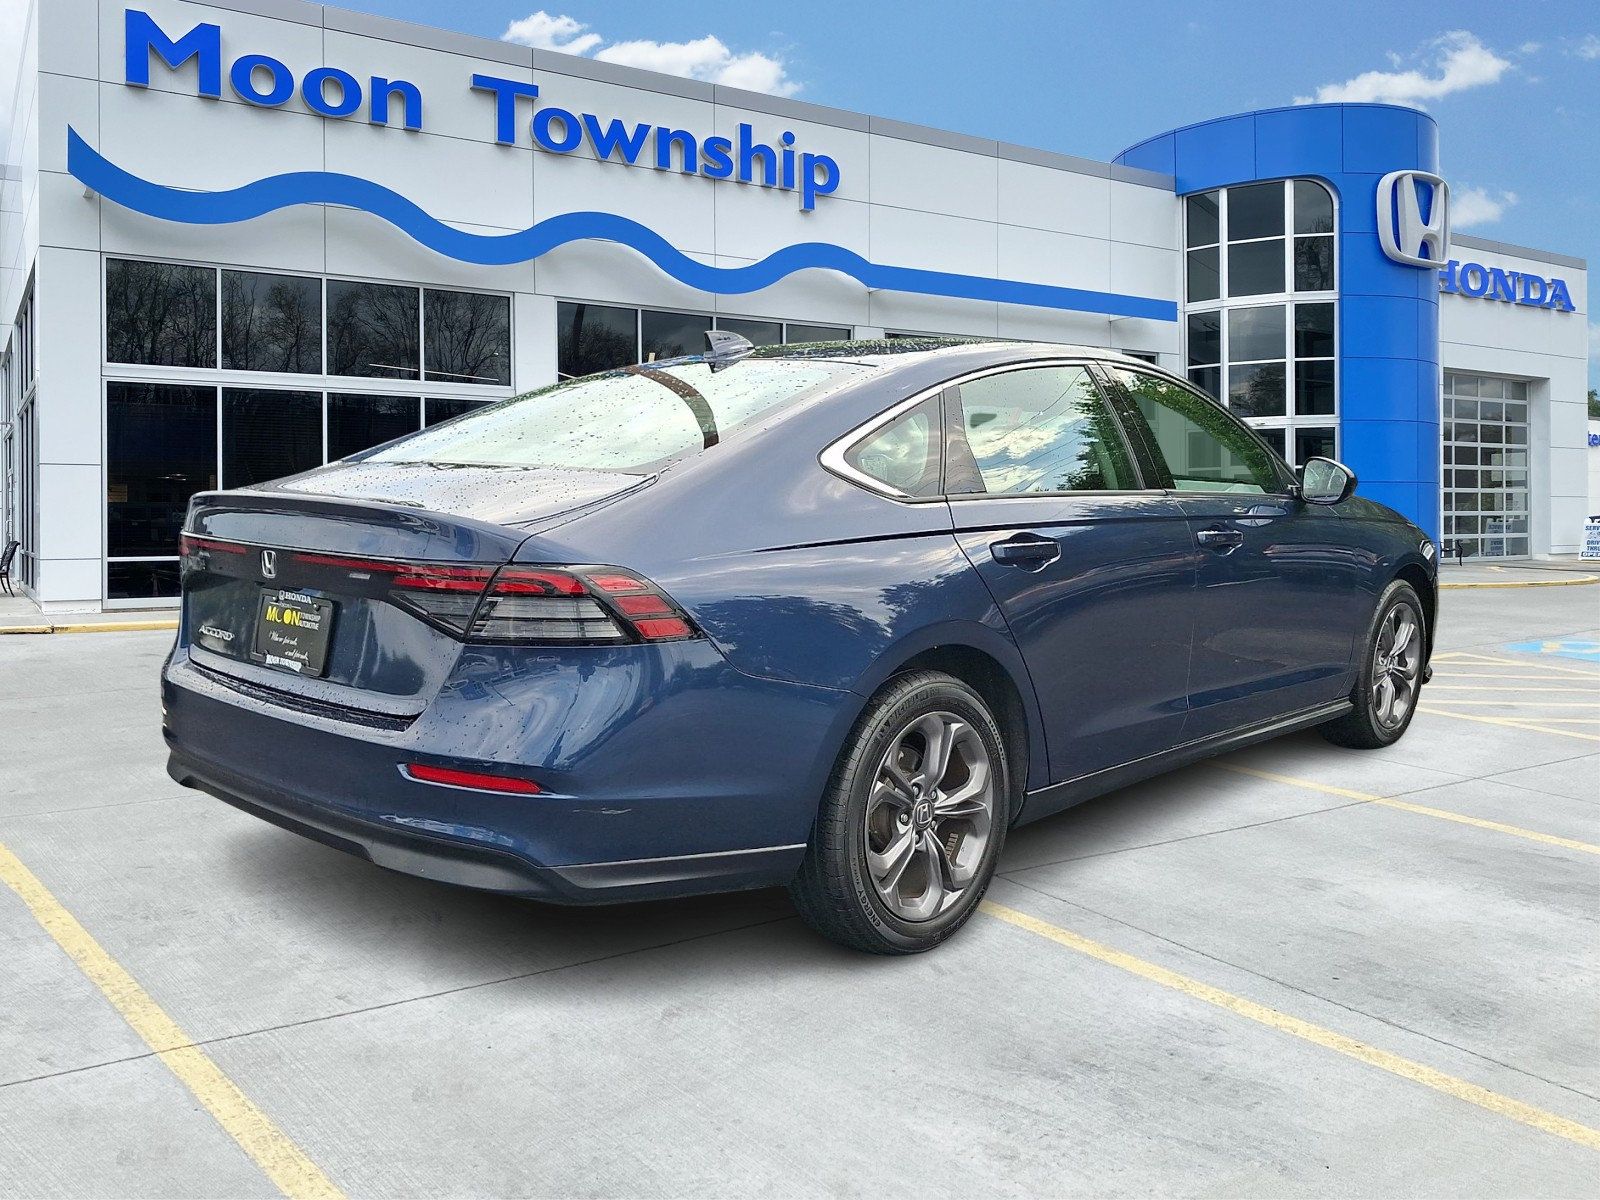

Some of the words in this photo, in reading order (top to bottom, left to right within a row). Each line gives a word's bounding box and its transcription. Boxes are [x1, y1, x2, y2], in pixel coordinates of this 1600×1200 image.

[125, 9, 422, 132] Moon
[470, 73, 841, 213] Township
[285, 591, 312, 604] HONDA
[199, 625, 235, 641] ACCORD
[857, 890, 881, 927] ENERGY
